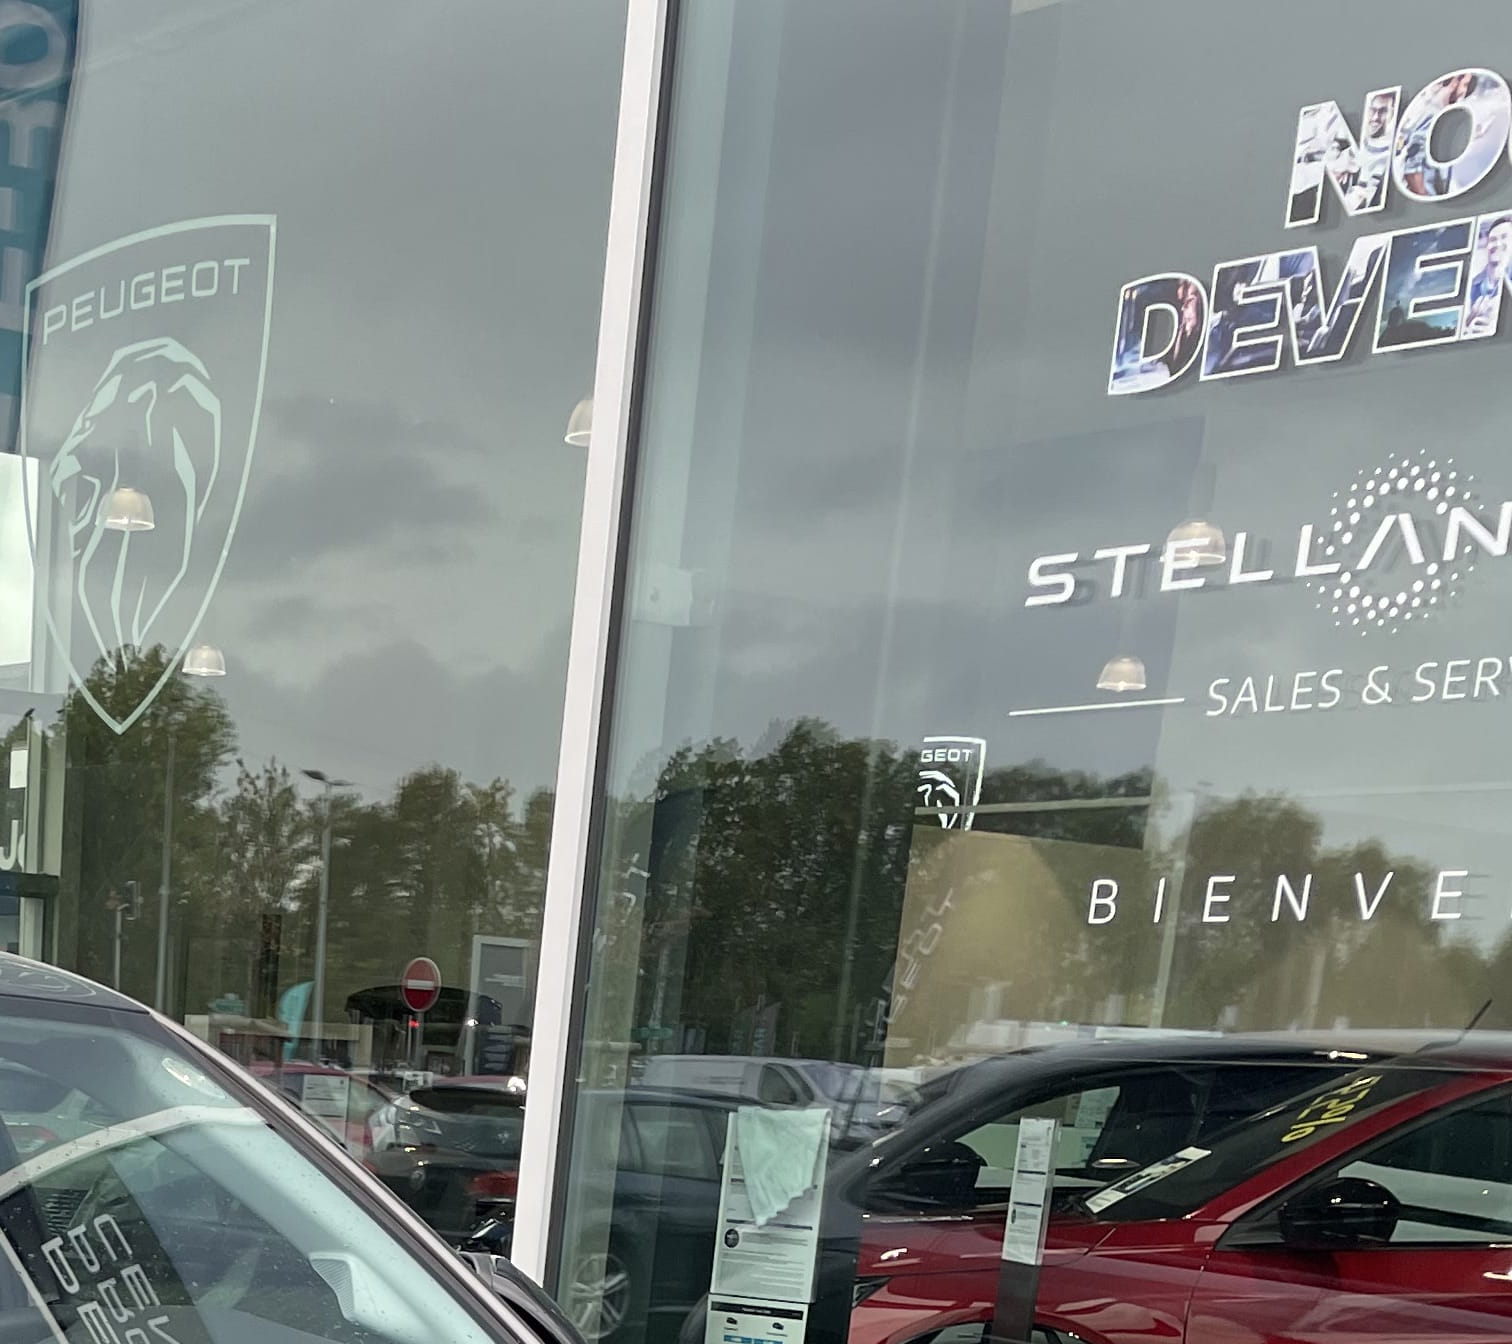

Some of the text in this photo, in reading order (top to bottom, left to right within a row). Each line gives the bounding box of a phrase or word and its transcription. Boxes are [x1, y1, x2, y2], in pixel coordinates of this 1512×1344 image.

[42, 257, 251, 345] PEUGEOT
[1025, 500, 1512, 607] STELLAN
[1206, 656, 1512, 716] SALES & SER
